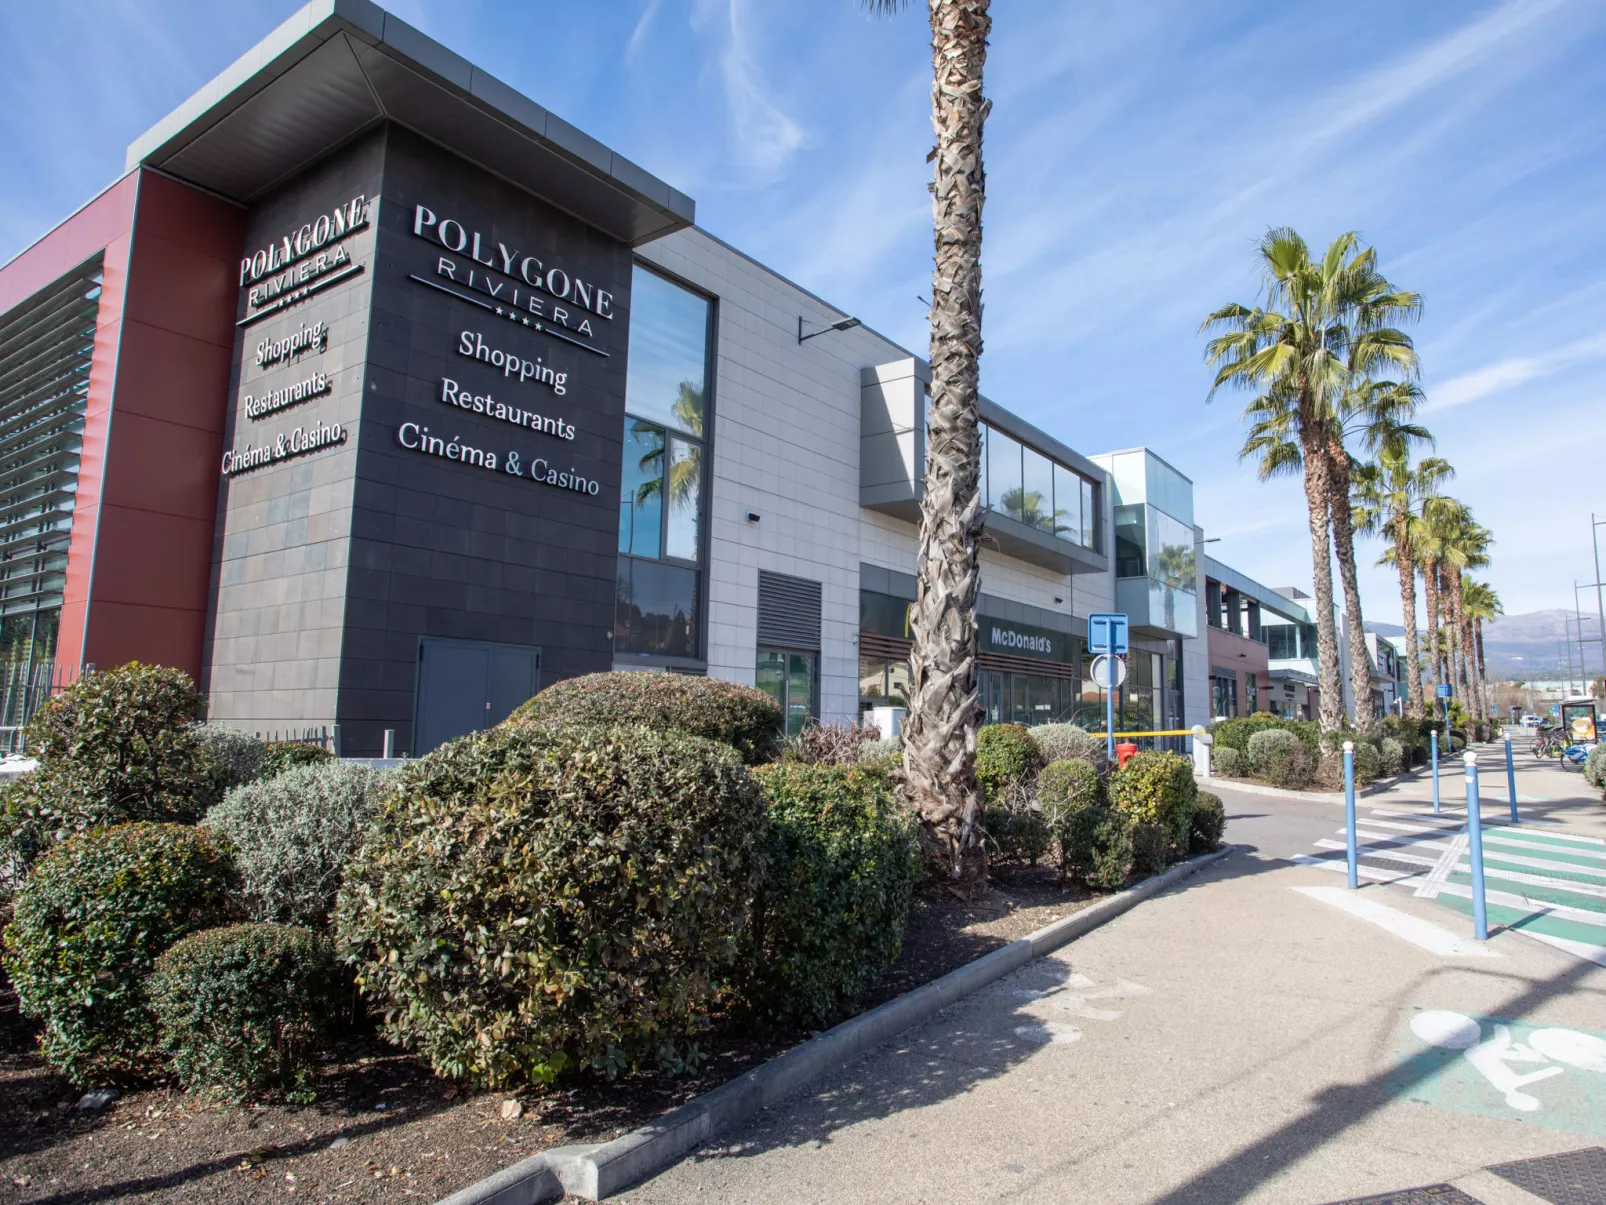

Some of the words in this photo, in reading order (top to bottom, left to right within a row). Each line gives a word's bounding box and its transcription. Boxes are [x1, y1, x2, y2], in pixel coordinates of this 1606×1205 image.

[240, 195, 366, 287] POLYGONE
[414, 204, 613, 320] POLYGONE
[248, 245, 346, 307] RIVIERA
[437, 257, 593, 336] RIVIERA
[256, 320, 323, 366] Shopping
[459, 331, 567, 395] Shopping
[244, 372, 327, 418] Restaurants
[441, 377, 576, 440] Restaurants
[221, 447, 271, 475] Cinéma
[274, 432, 288, 457] &
[290, 421, 342, 450] Casino
[398, 422, 497, 469] Cinéma
[505, 451, 523, 476] &
[530, 458, 600, 495] Casino
[991, 627, 1052, 653] McDonald's
